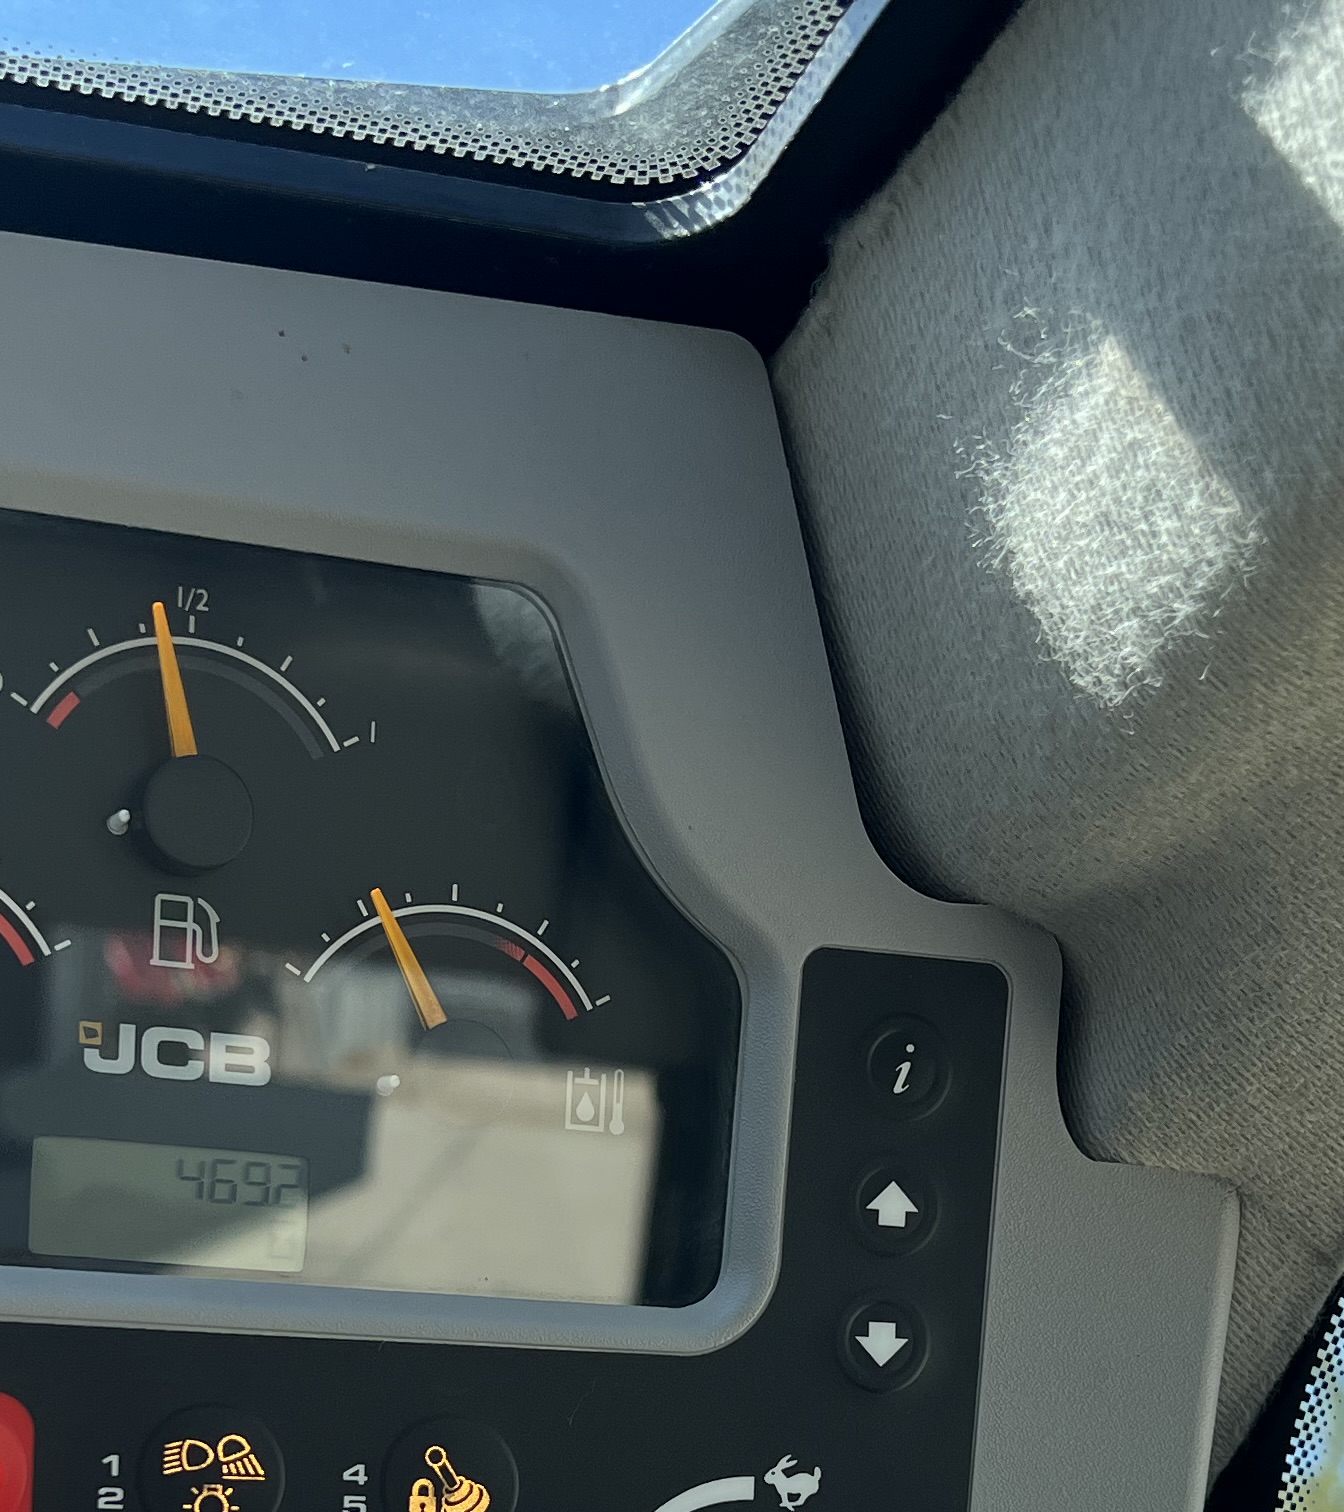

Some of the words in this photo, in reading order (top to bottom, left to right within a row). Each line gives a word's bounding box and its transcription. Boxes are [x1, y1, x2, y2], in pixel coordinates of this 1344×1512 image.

[83, 1022, 272, 1087] JCB
[101, 1454, 120, 1477] 1
[342, 1463, 369, 1486] 4
[96, 1486, 124, 1510] 2
